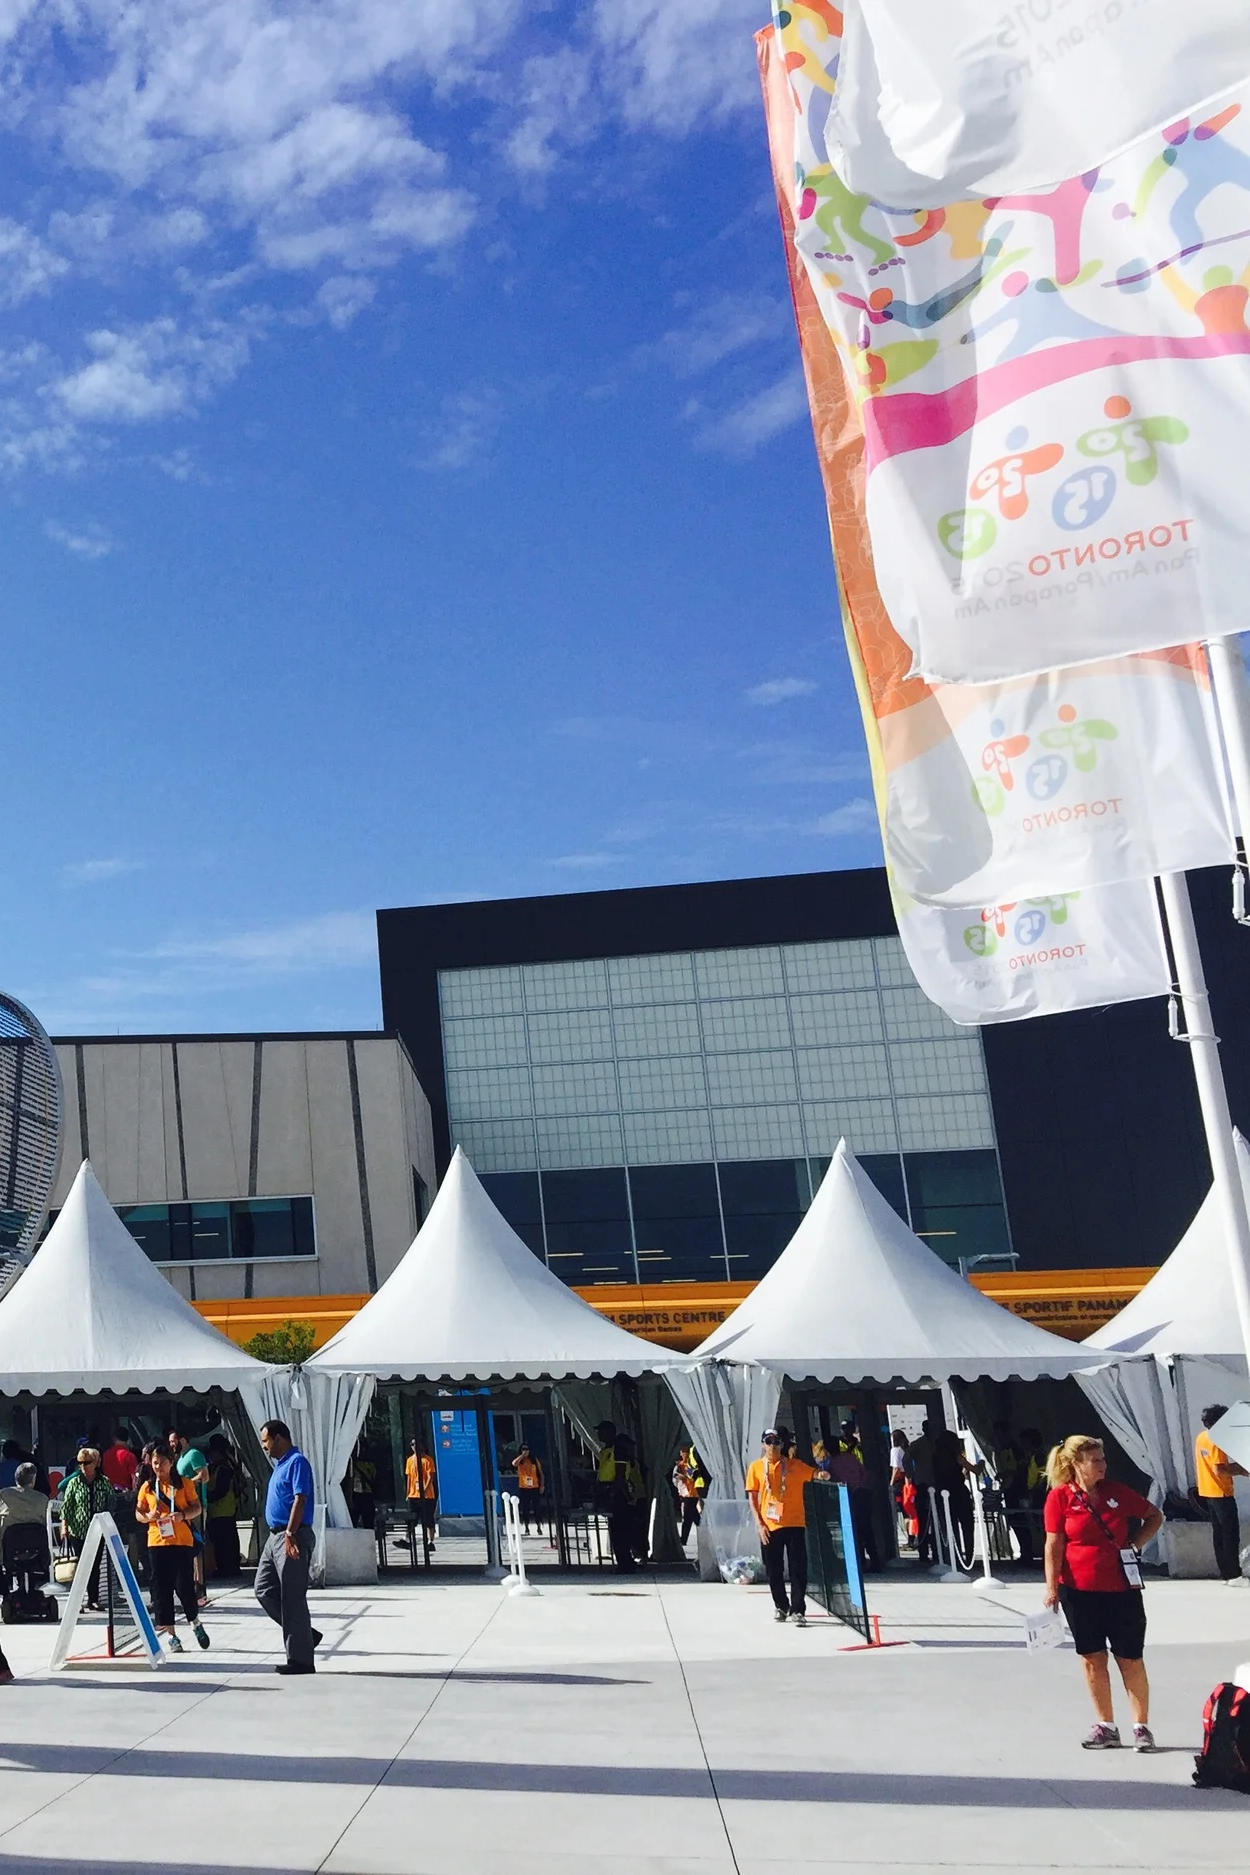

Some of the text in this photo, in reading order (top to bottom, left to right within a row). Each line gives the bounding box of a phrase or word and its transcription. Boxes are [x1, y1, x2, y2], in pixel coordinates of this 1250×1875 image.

[1014, 1300, 1074, 1314] SPORTIF
[619, 1313, 670, 1326] SPORTS
[673, 1311, 726, 1325] CENTRE
